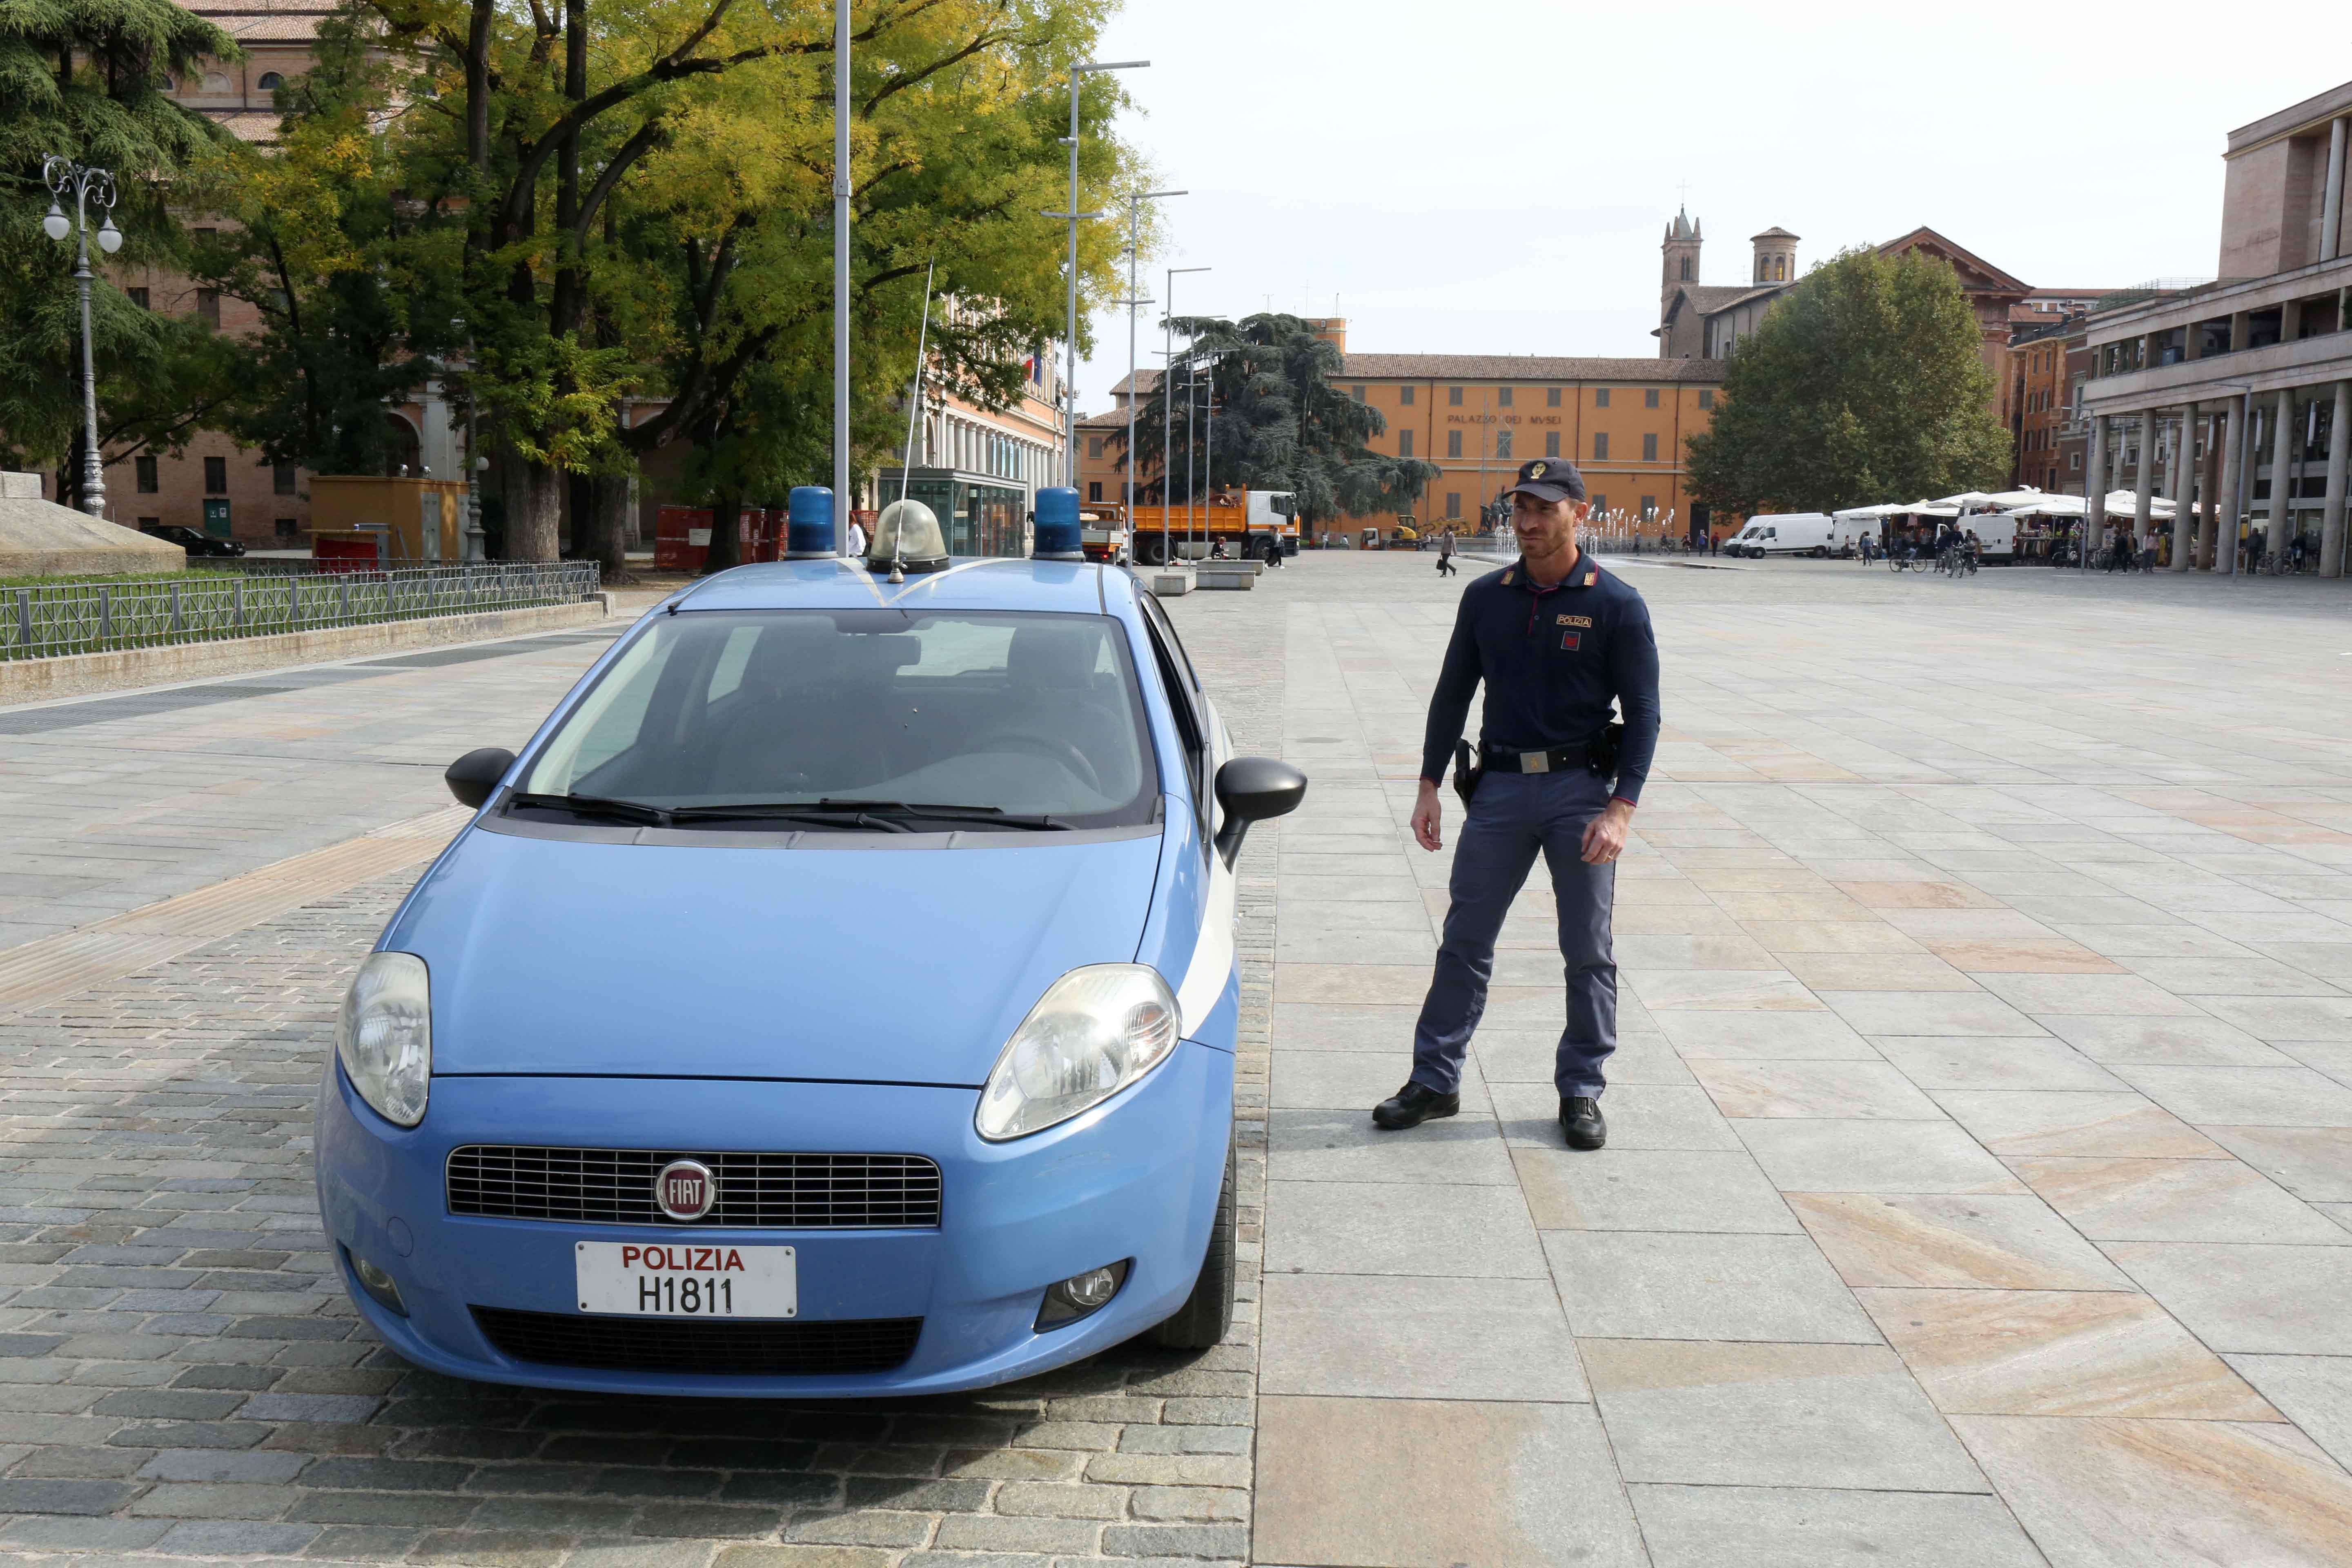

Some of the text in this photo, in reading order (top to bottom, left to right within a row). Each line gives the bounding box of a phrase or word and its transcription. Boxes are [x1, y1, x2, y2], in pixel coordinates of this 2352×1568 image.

[1448, 414, 1561, 425] PALAZO DEI MVSEI
[1558, 616, 1589, 626] POLIZIA
[669, 1179, 702, 1205] FIAT
[622, 1246, 745, 1271] POLIZIA
[639, 1276, 731, 1314] H1811
